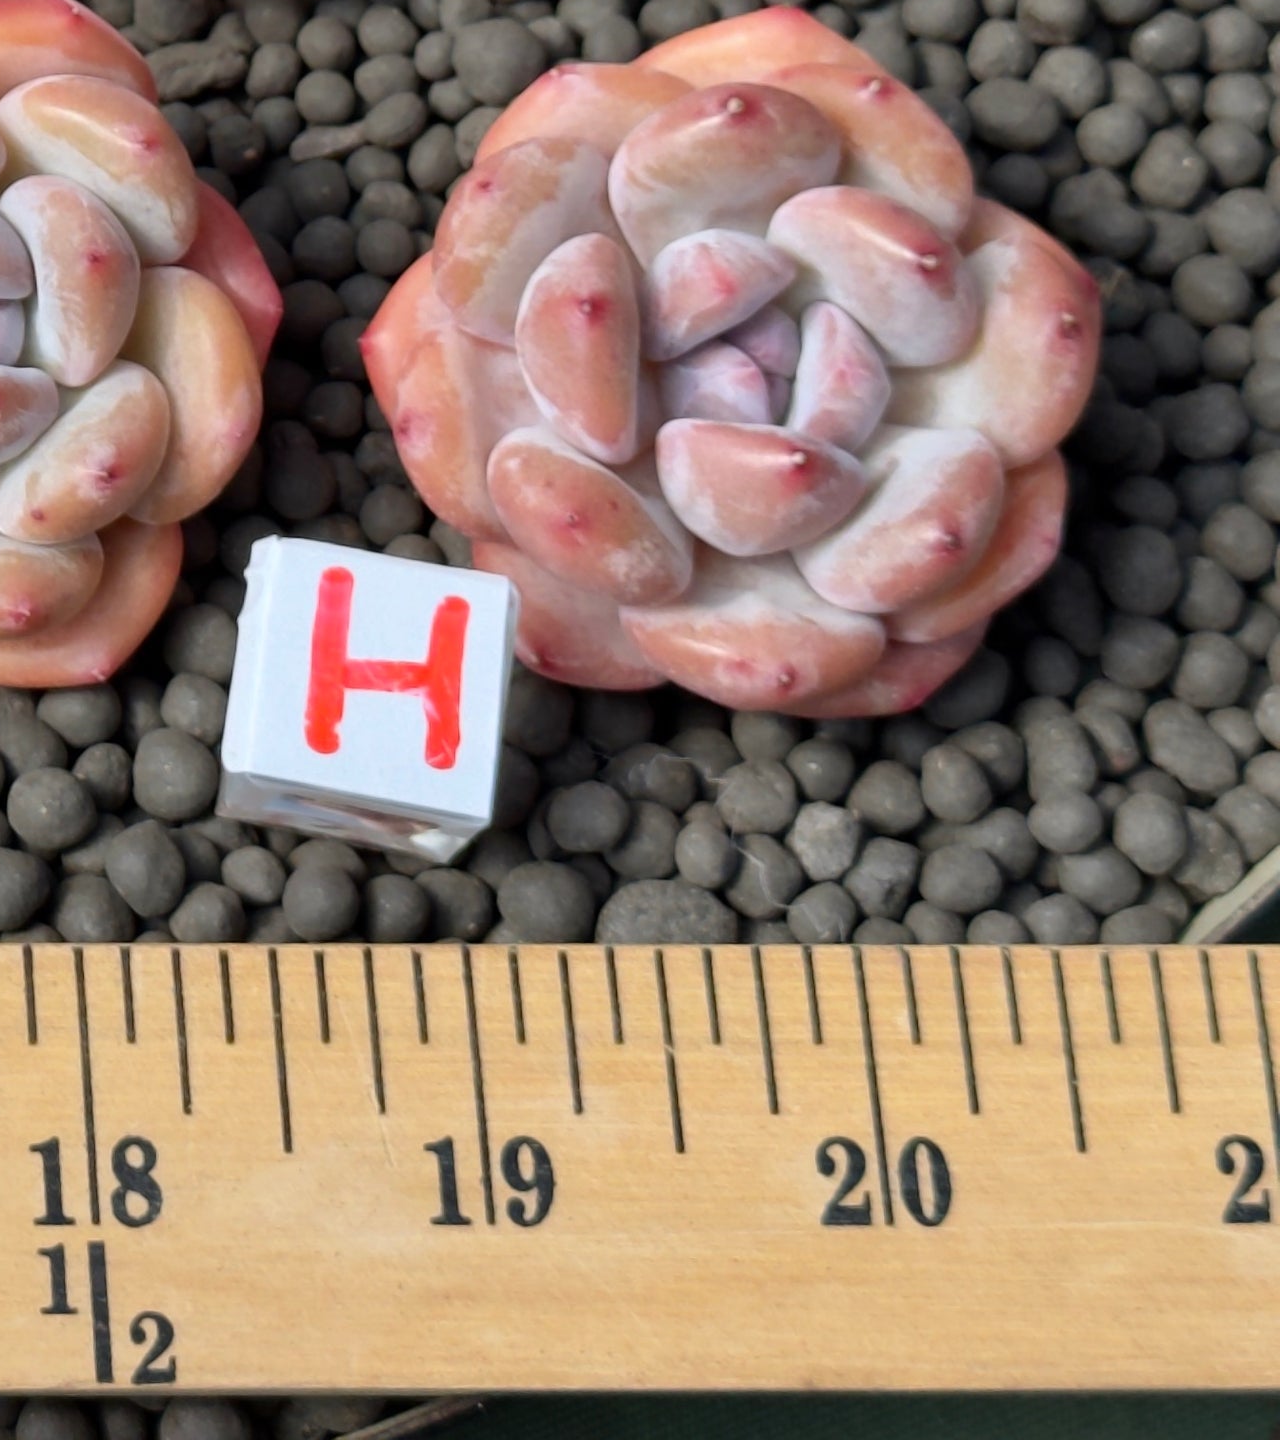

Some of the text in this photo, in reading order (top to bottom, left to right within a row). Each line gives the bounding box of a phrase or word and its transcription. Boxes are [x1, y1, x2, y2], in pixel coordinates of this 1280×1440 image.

[306, 568, 469, 769] H
[31, 1137, 163, 1227] 18
[426, 1136, 556, 1227] 19
[816, 1136, 953, 1227] 20
